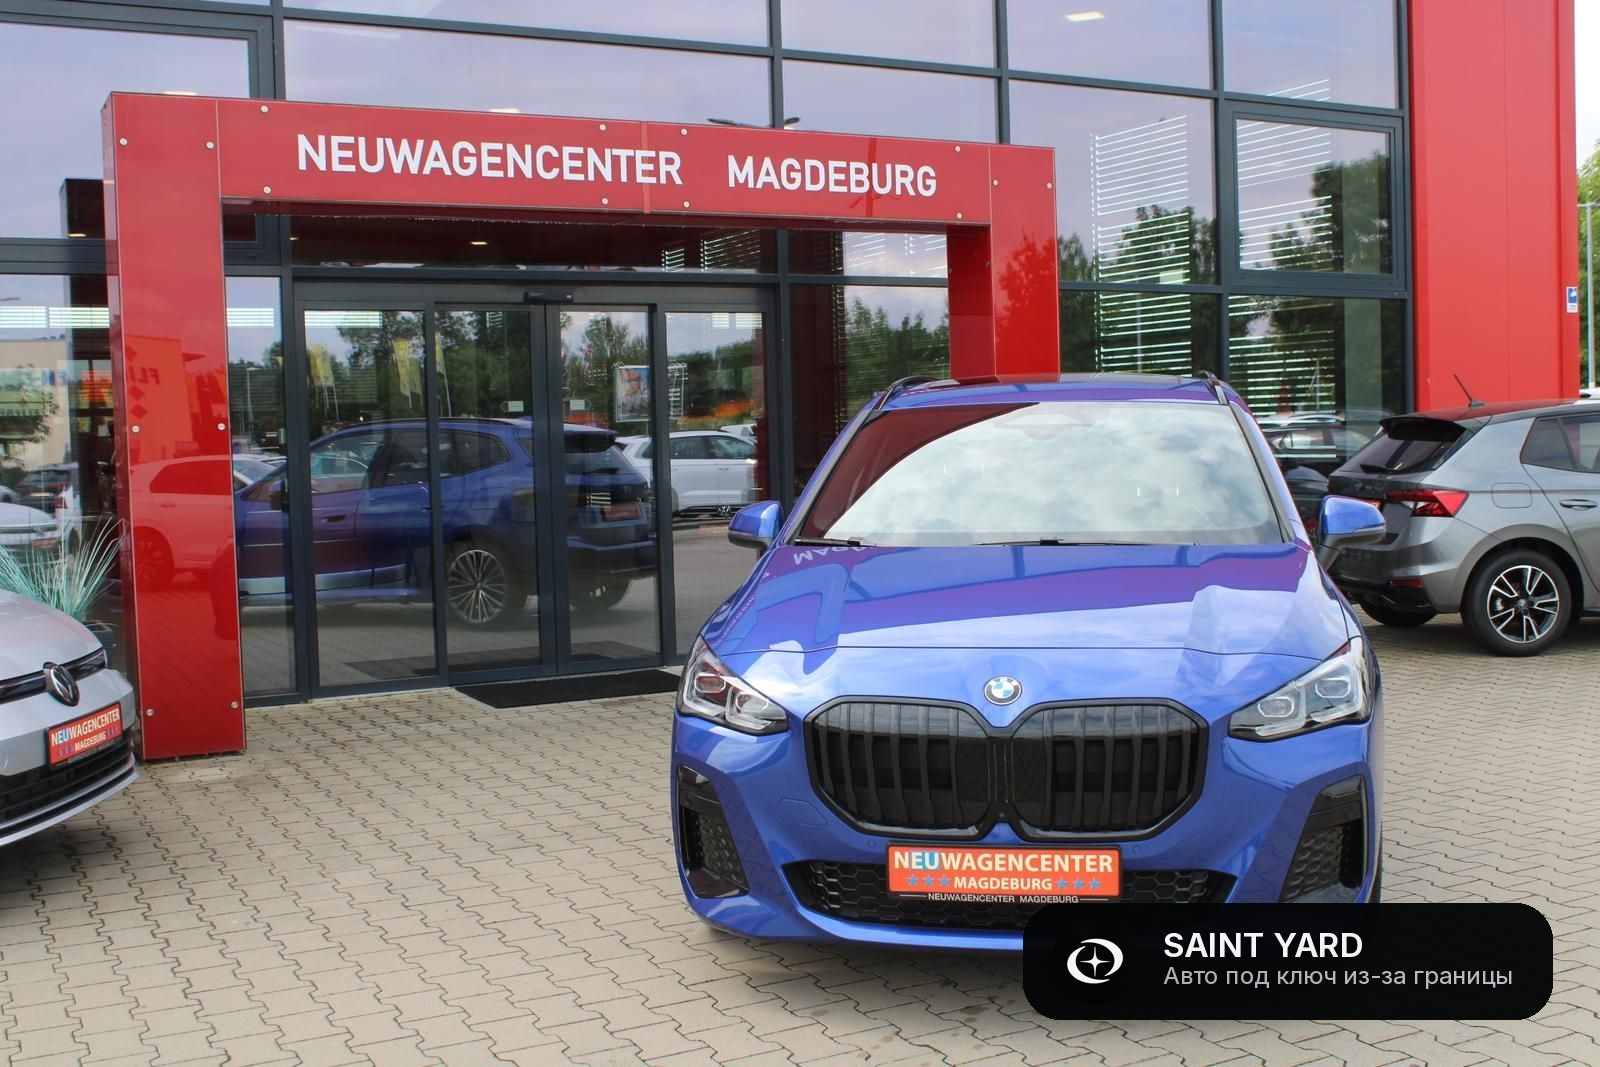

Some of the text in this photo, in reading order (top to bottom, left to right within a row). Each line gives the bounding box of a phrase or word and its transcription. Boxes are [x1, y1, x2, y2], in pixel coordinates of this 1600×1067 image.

[297, 134, 937, 197] NEUWAGENCENTER MAGDEBURG
[51, 708, 120, 747] NEUWAGENCENTER
[74, 731, 107, 752] MAGDEBURG
[894, 851, 1113, 873] NEUWAGENCENTER
[953, 876, 1053, 890] MAGDEBURG
[928, 893, 1079, 904] NEUWAGENCENTER MAGDEBURG
